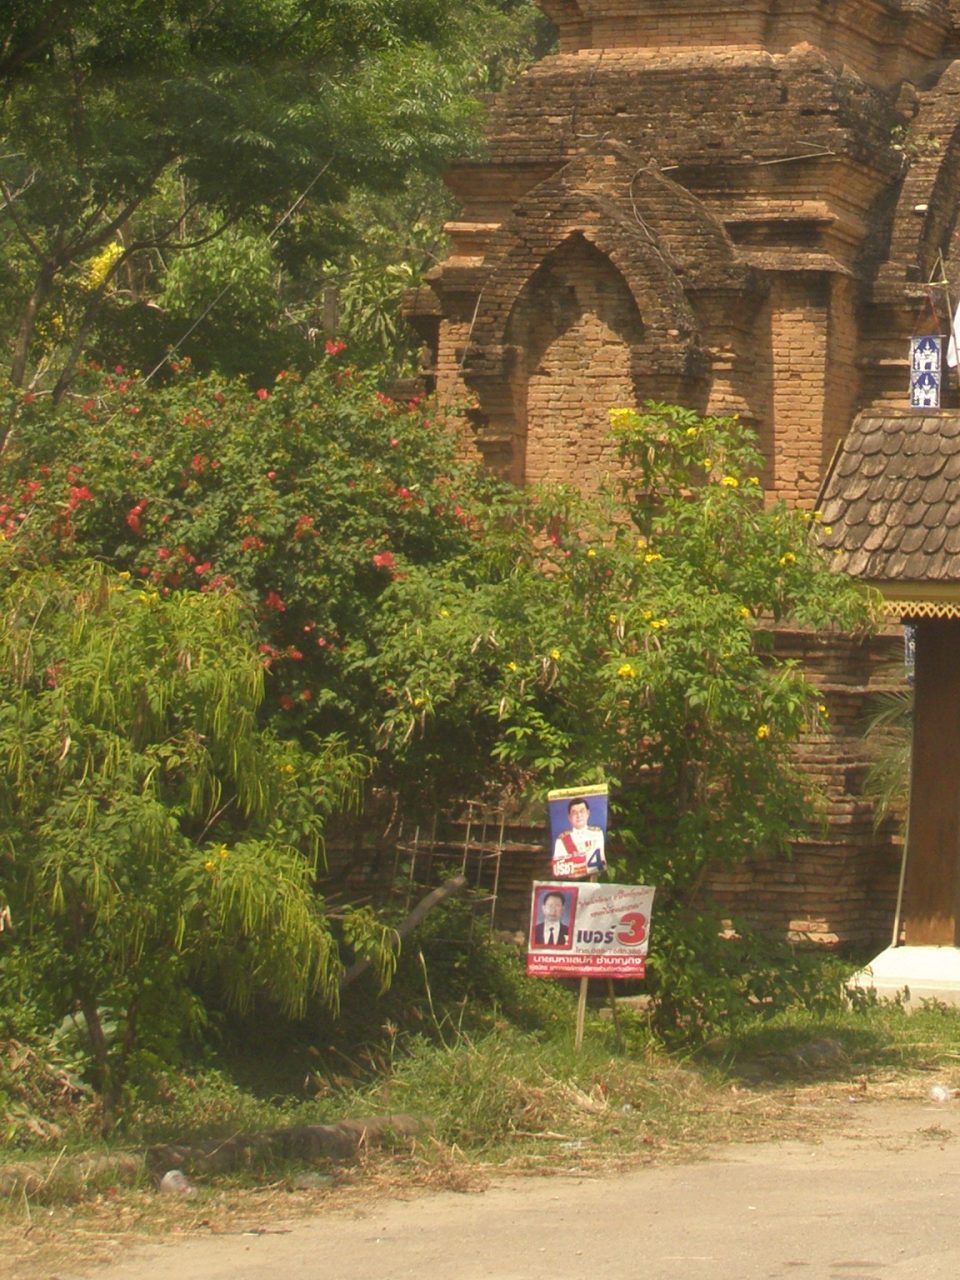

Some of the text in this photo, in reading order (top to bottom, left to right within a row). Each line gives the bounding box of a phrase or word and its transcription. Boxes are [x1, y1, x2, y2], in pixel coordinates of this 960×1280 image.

[587, 848, 605, 870] 4
[576, 911, 647, 946] เบอร์ 3
